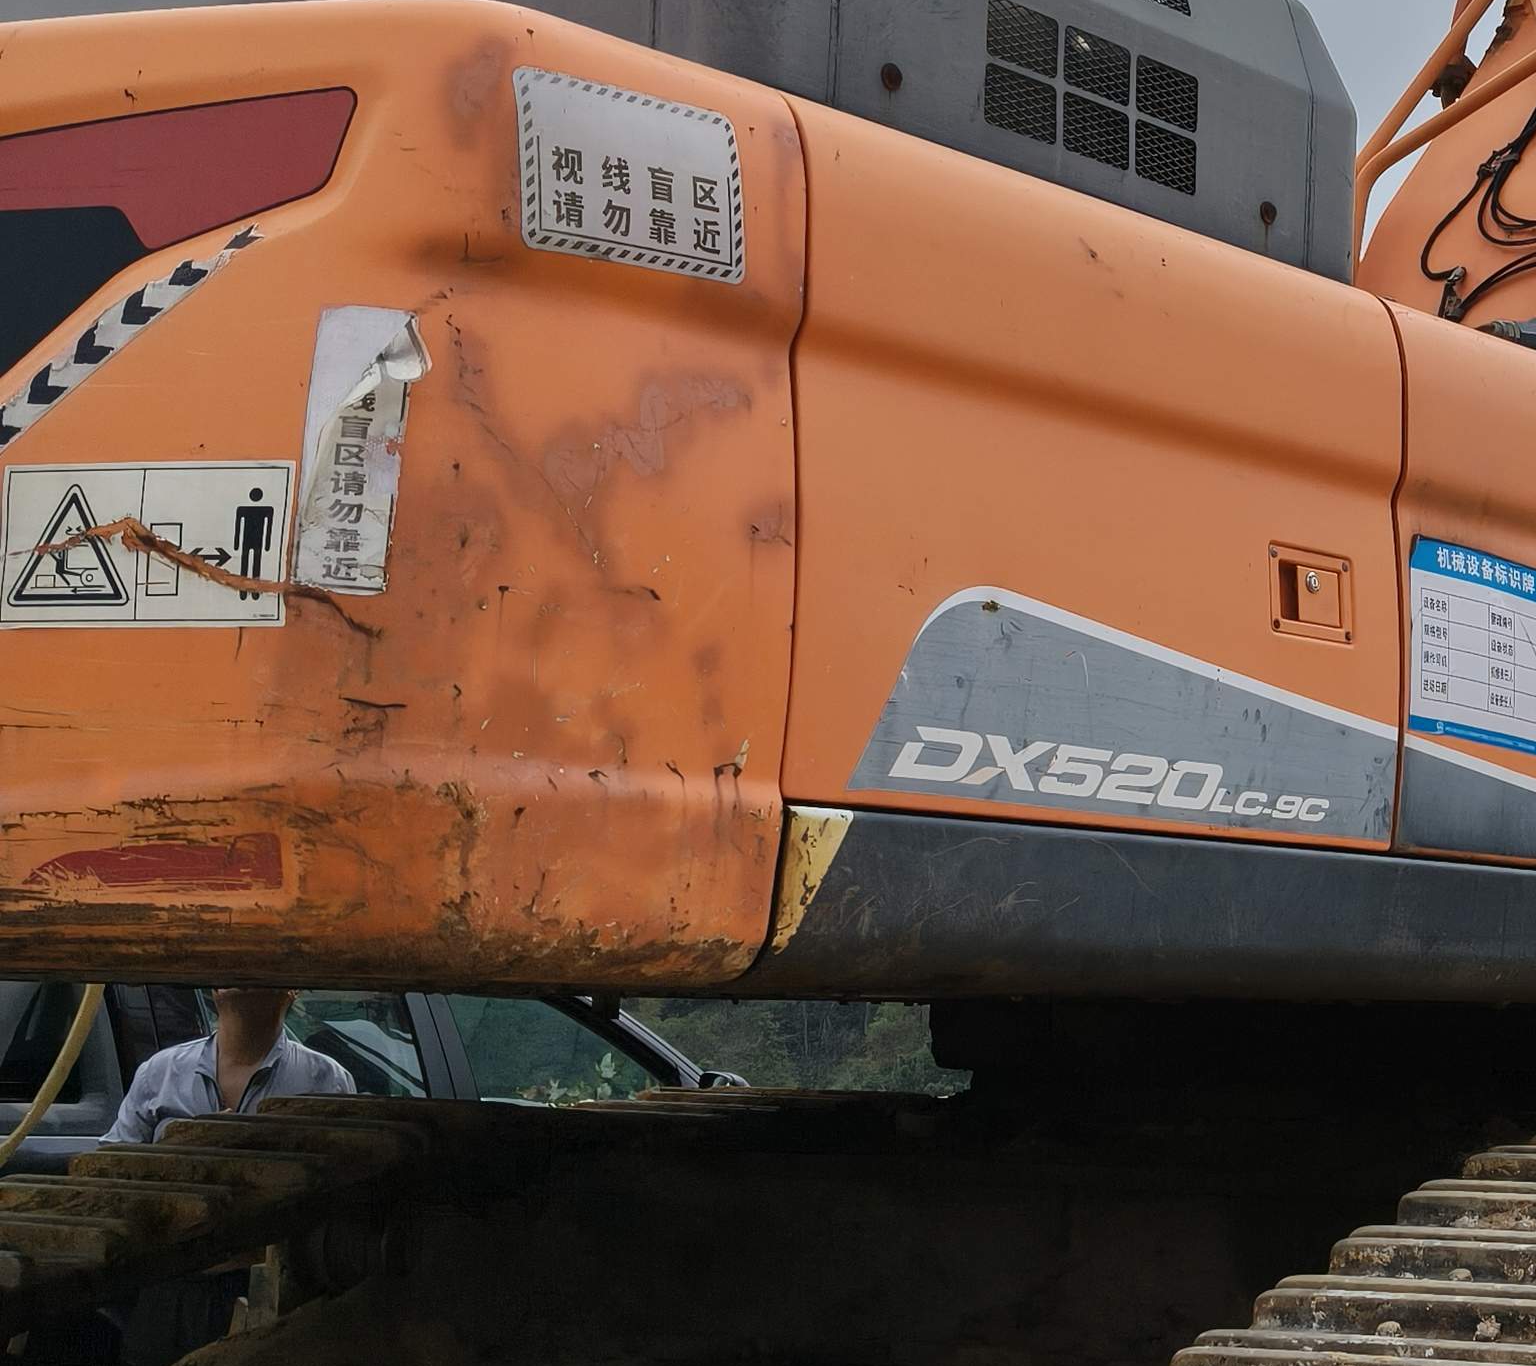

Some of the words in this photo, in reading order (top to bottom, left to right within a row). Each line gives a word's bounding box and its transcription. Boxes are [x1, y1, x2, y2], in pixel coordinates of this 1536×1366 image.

[551, 145, 720, 213] 视线盲区
[552, 188, 722, 256] 请勿靠近
[1436, 546, 1536, 594] 机械设备标识牌
